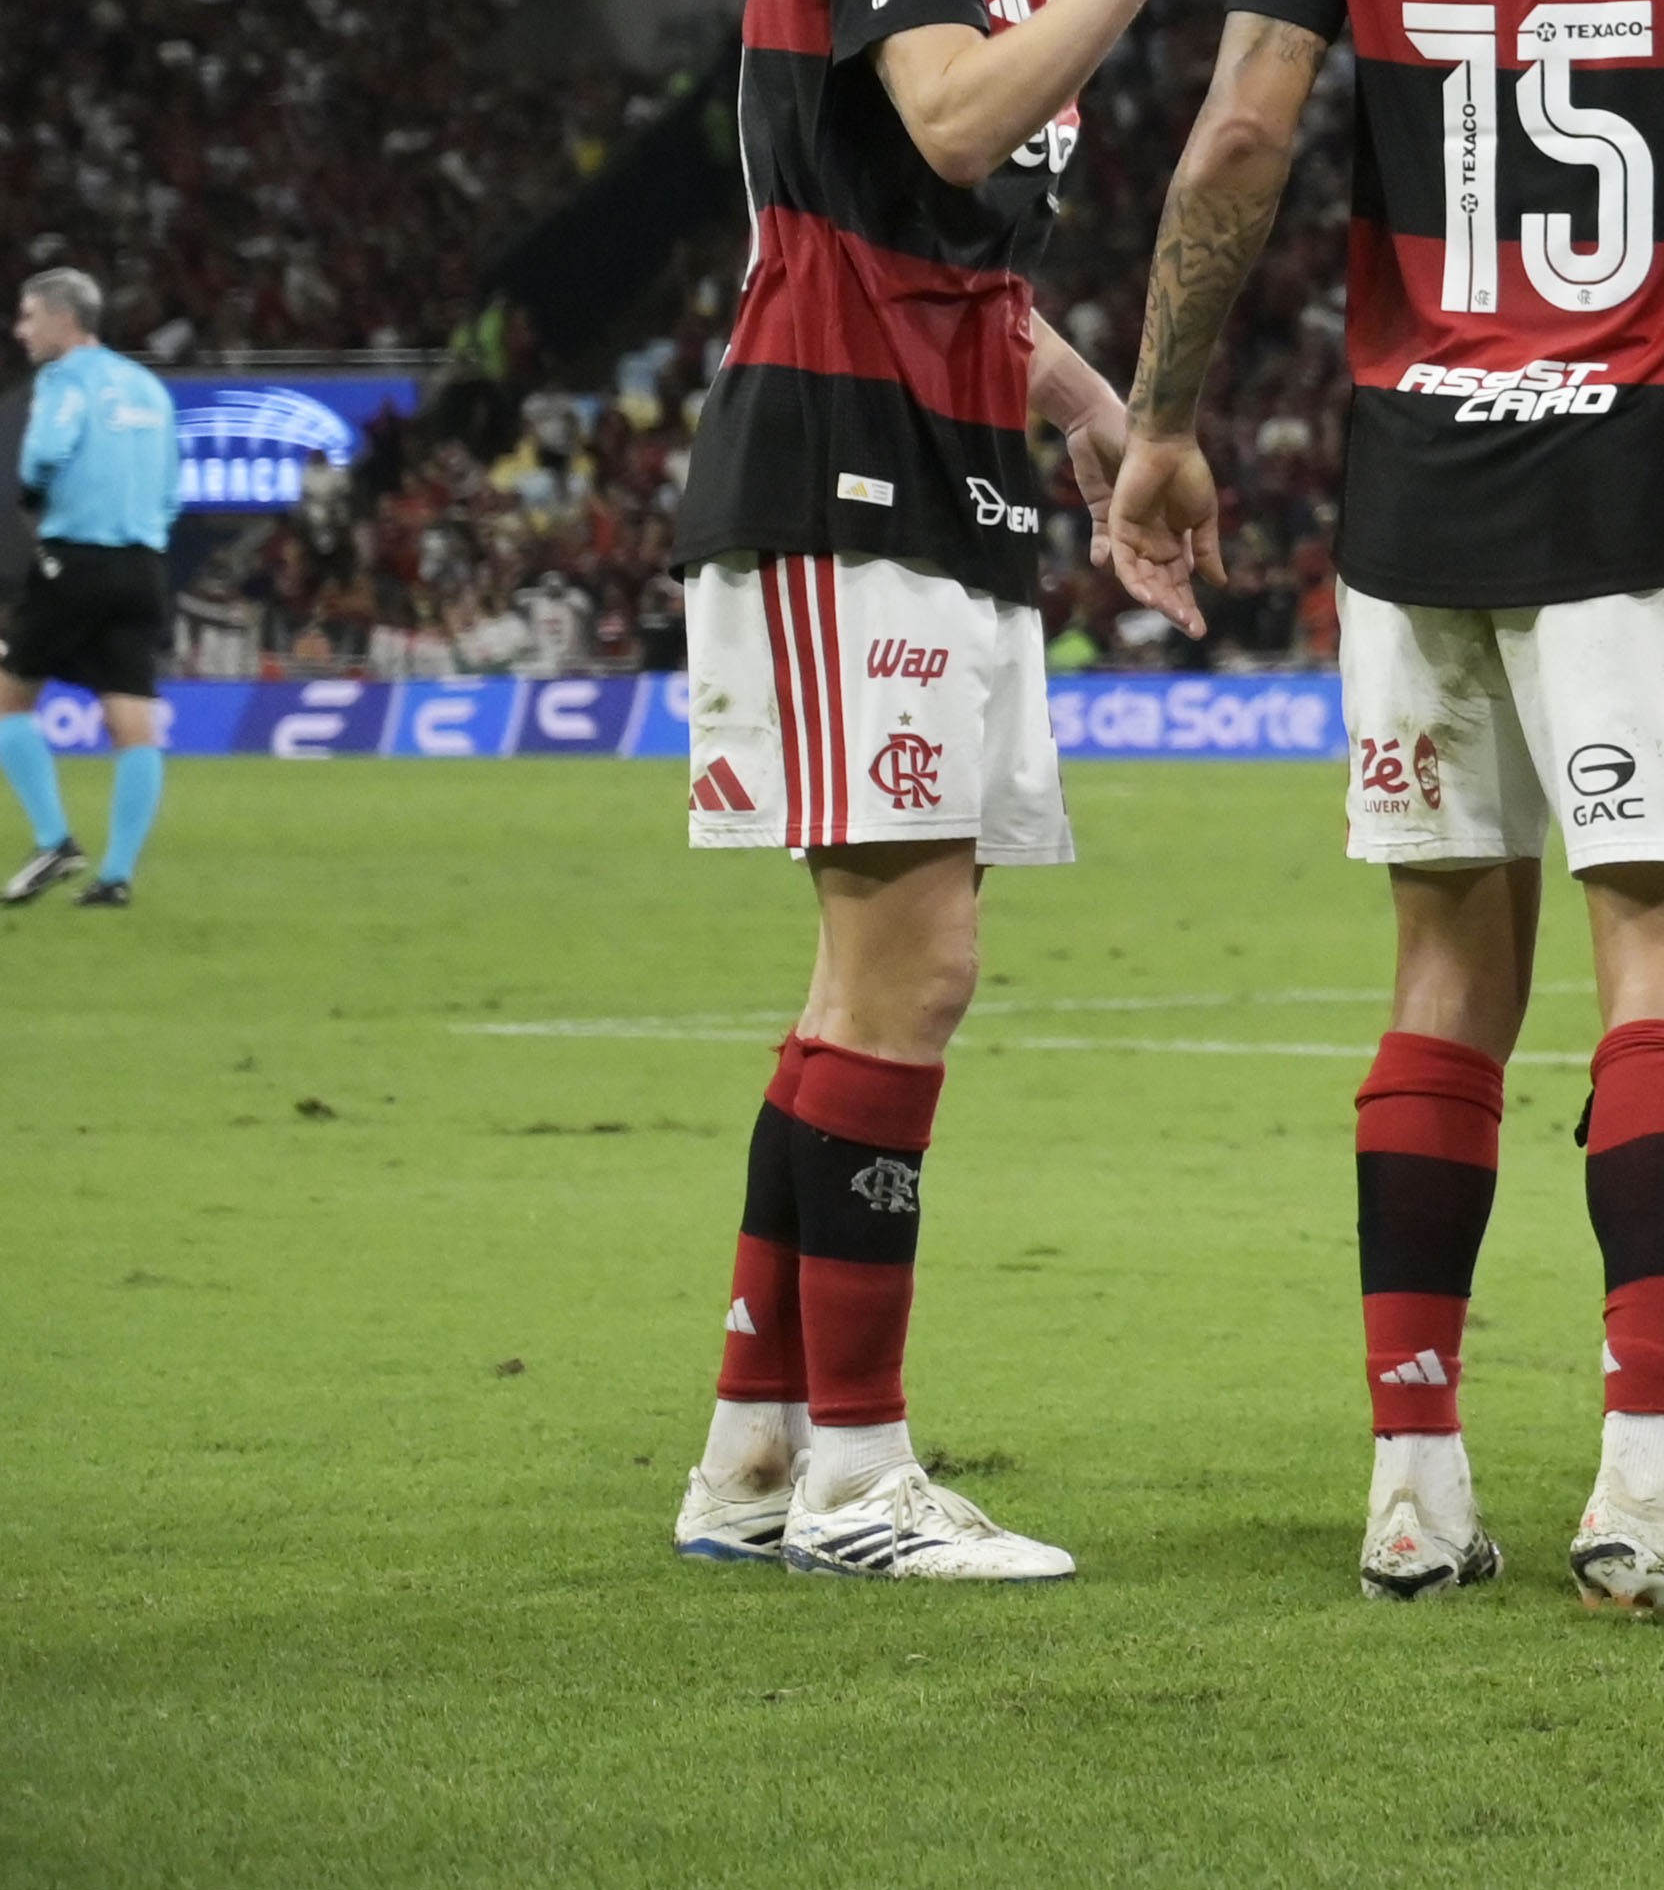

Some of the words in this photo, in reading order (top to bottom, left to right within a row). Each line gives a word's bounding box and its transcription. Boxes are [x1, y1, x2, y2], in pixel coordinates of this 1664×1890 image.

[1563, 20, 1644, 40] TEXACO
[1402, 0, 1654, 313] 15
[1462, 103, 1477, 186] TEXACO
[867, 638, 949, 687] Wap
[1089, 684, 1163, 750] da
[1166, 678, 1327, 750] Sorte
[1572, 797, 1646, 828] GAC
